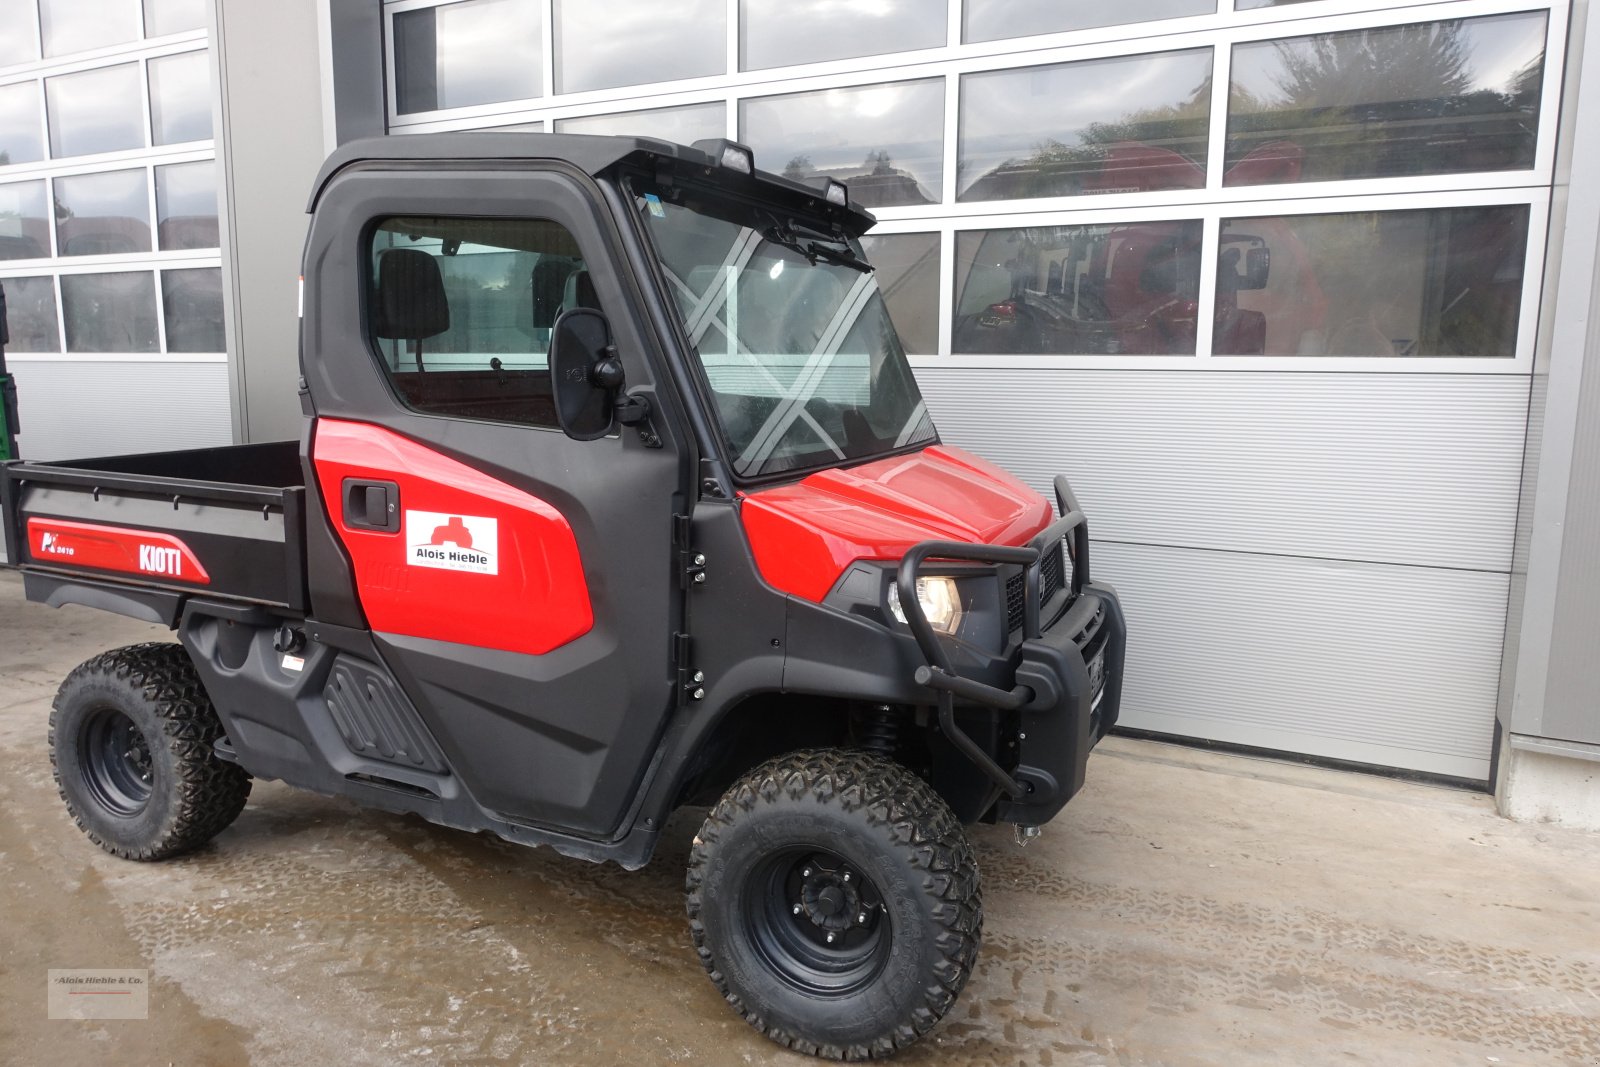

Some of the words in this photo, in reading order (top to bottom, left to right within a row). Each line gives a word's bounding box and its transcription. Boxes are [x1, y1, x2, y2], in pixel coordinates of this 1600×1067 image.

[139, 544, 181, 576] KIOTI
[416, 548, 445, 560] Alois
[449, 551, 487, 565] Hieble
